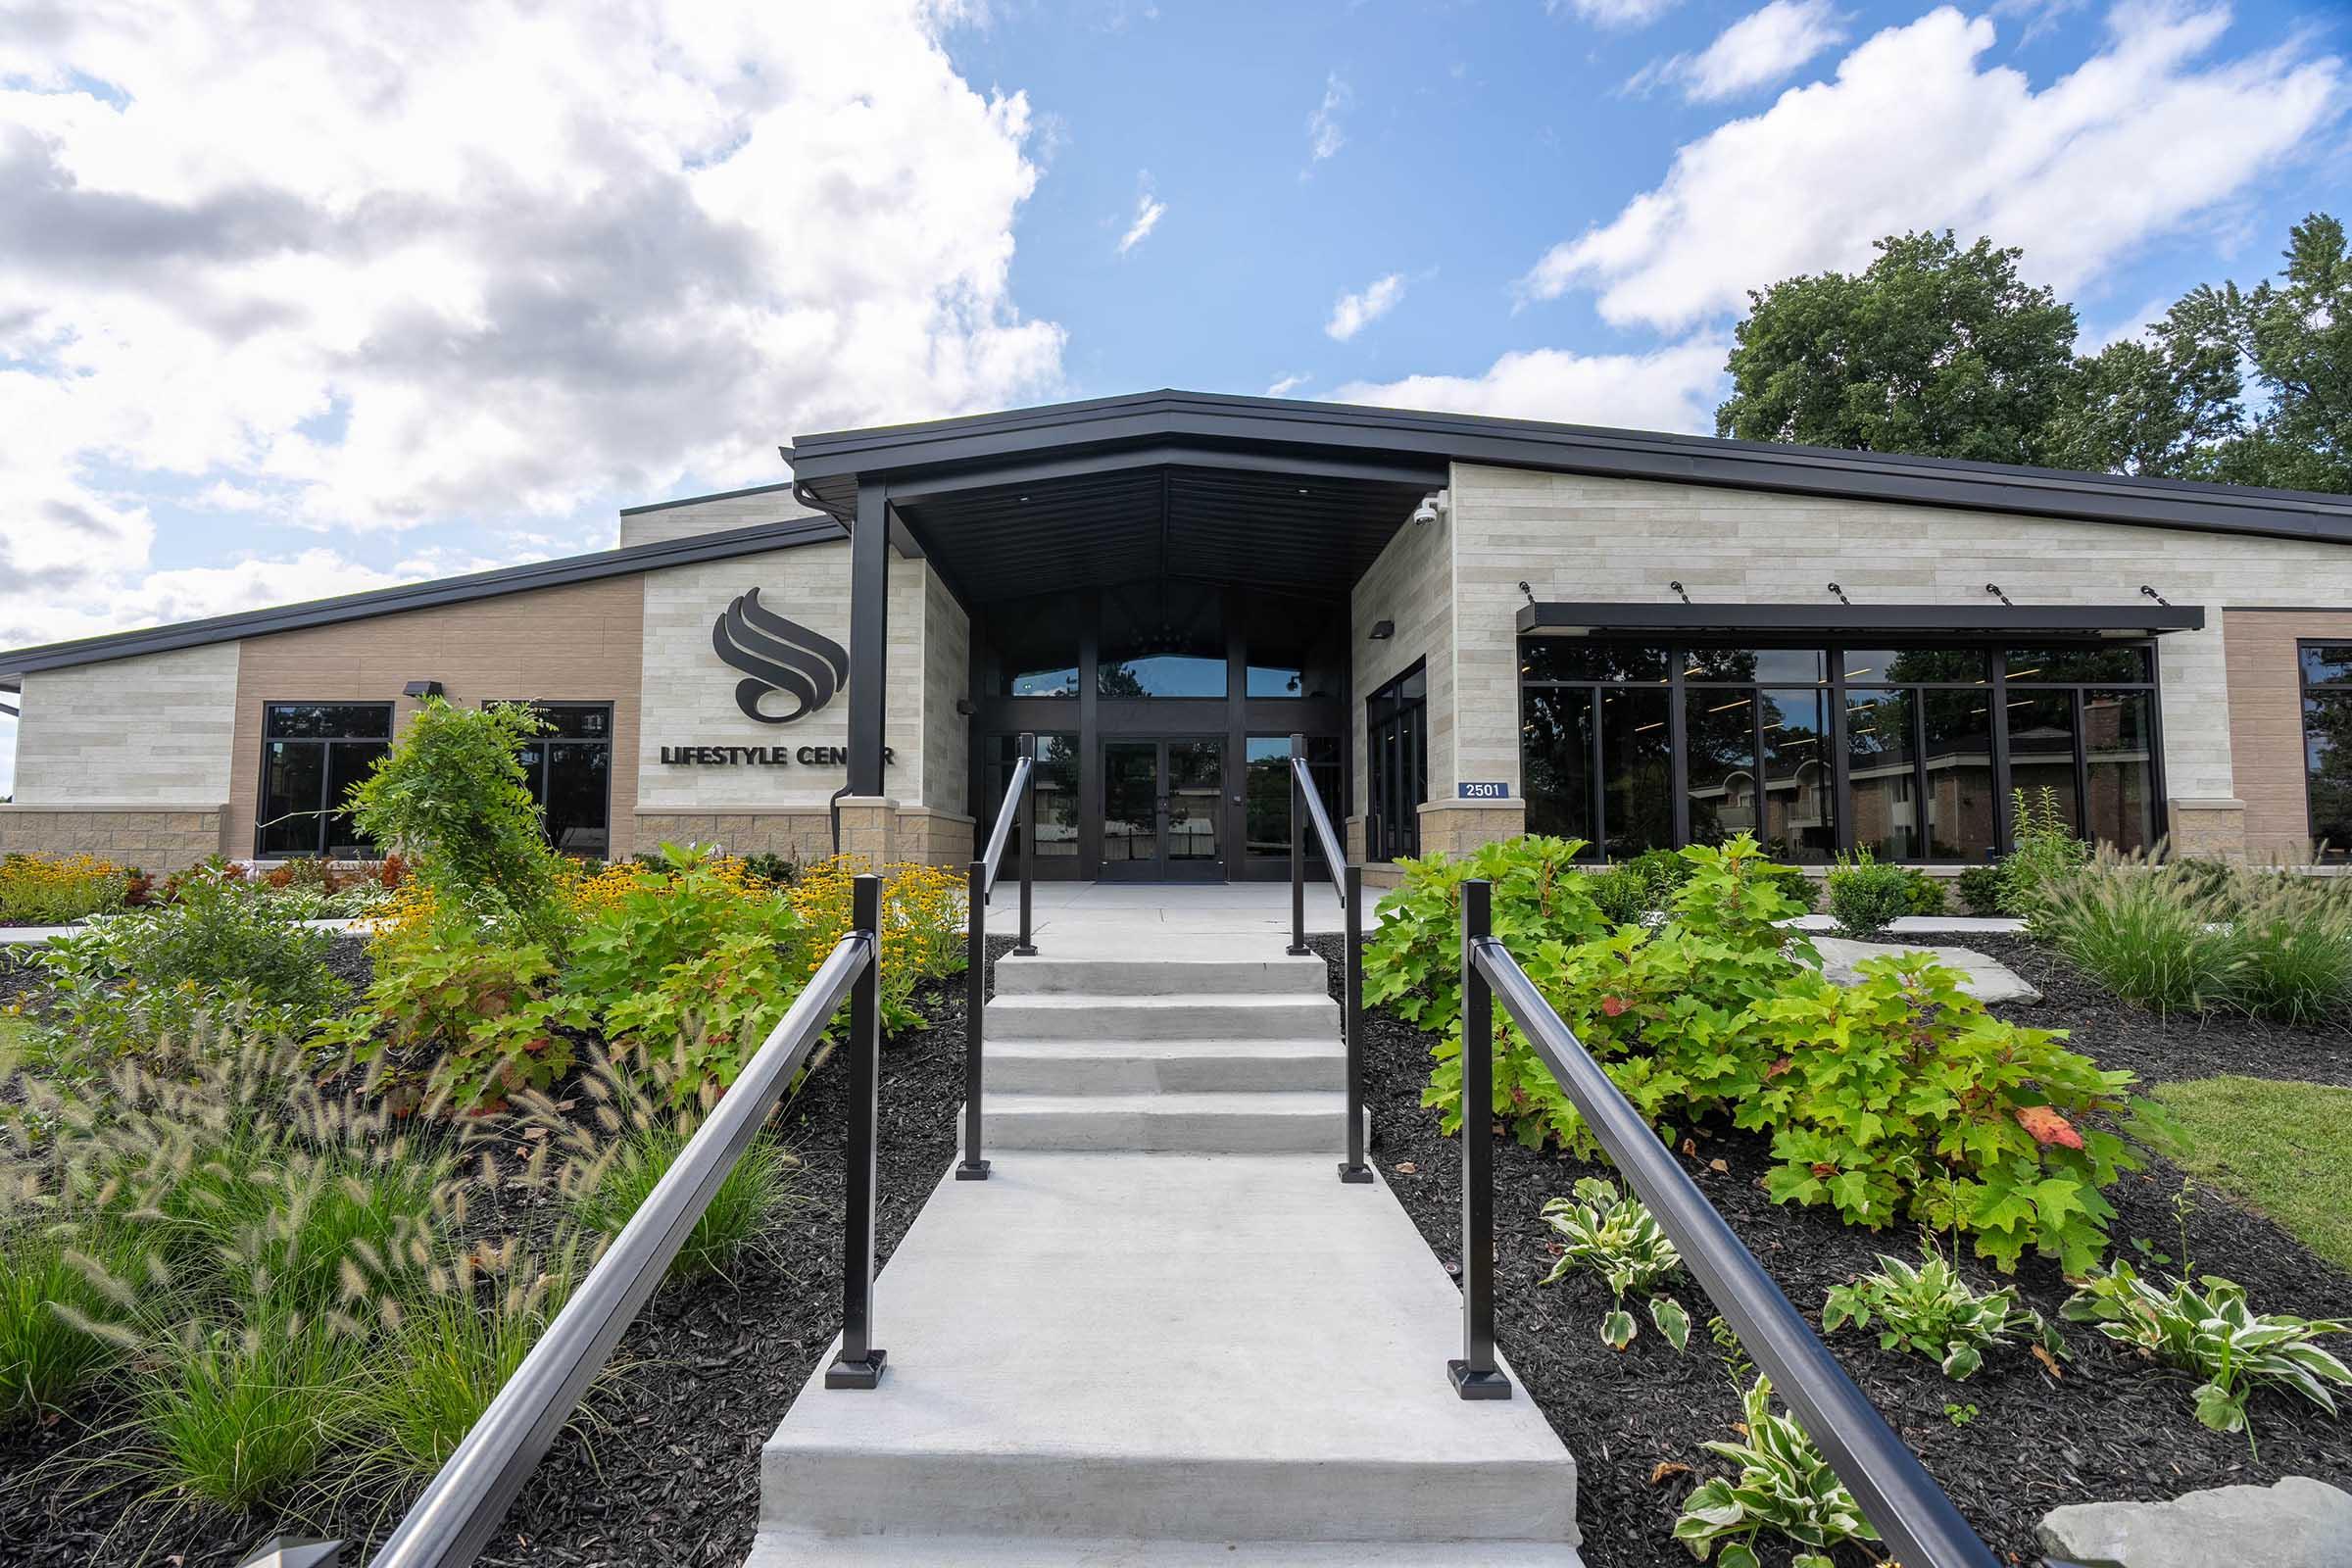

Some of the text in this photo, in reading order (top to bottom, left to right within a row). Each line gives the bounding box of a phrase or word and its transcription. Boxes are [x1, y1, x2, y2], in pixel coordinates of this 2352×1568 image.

[661, 746, 894, 765] LIFESTYLE CENR
[1466, 784, 1499, 797] 2501
